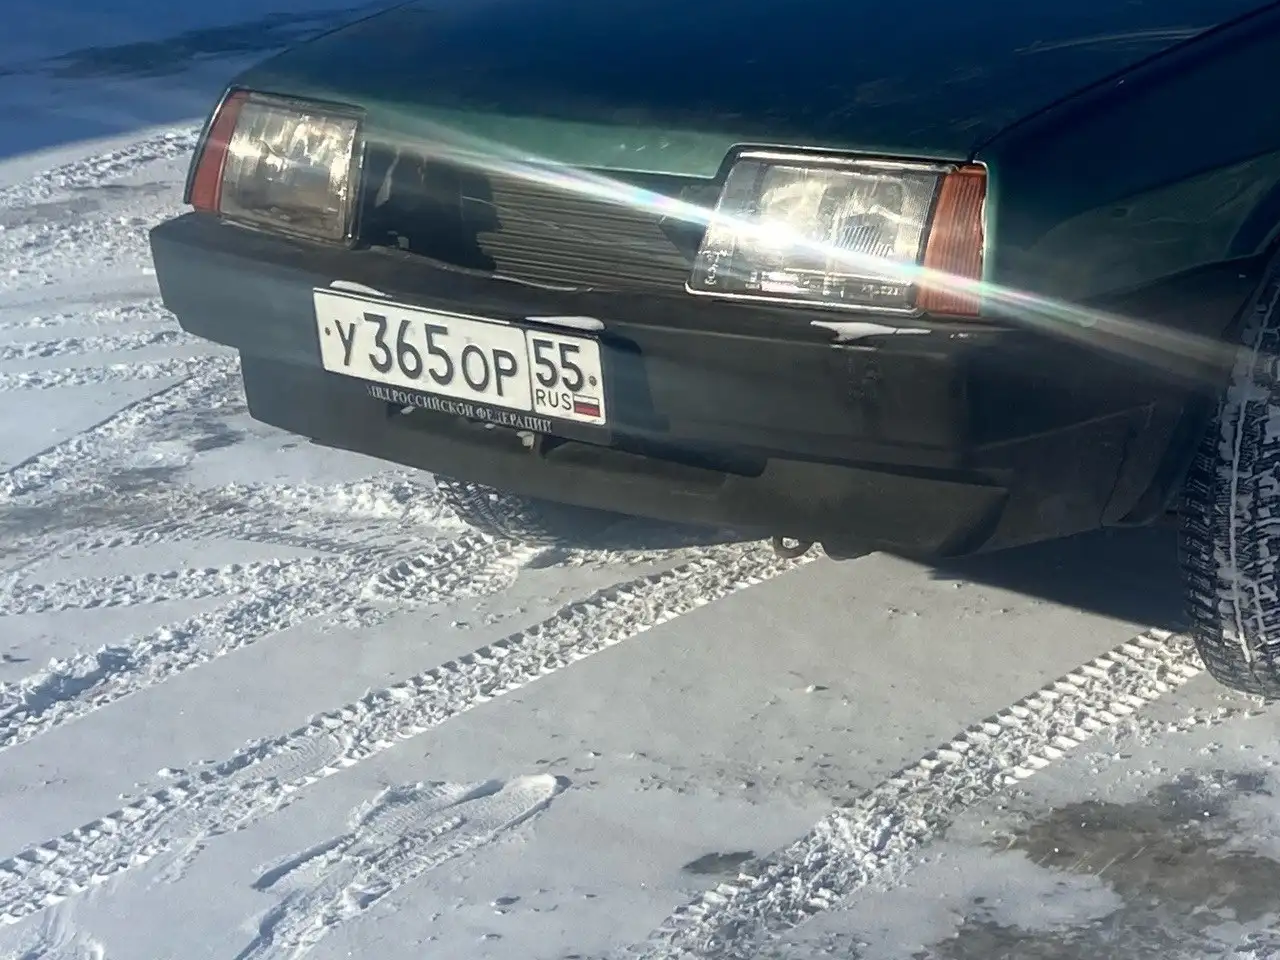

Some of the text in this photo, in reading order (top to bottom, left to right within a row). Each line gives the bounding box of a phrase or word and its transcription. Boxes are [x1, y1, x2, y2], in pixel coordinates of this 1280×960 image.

[532, 338, 585, 393] 55
[392, 389, 474, 417] РОССИЙСКОЙ
[476, 407, 553, 433] ФЕДЕРАЦИИ
[536, 388, 573, 411] RUS
